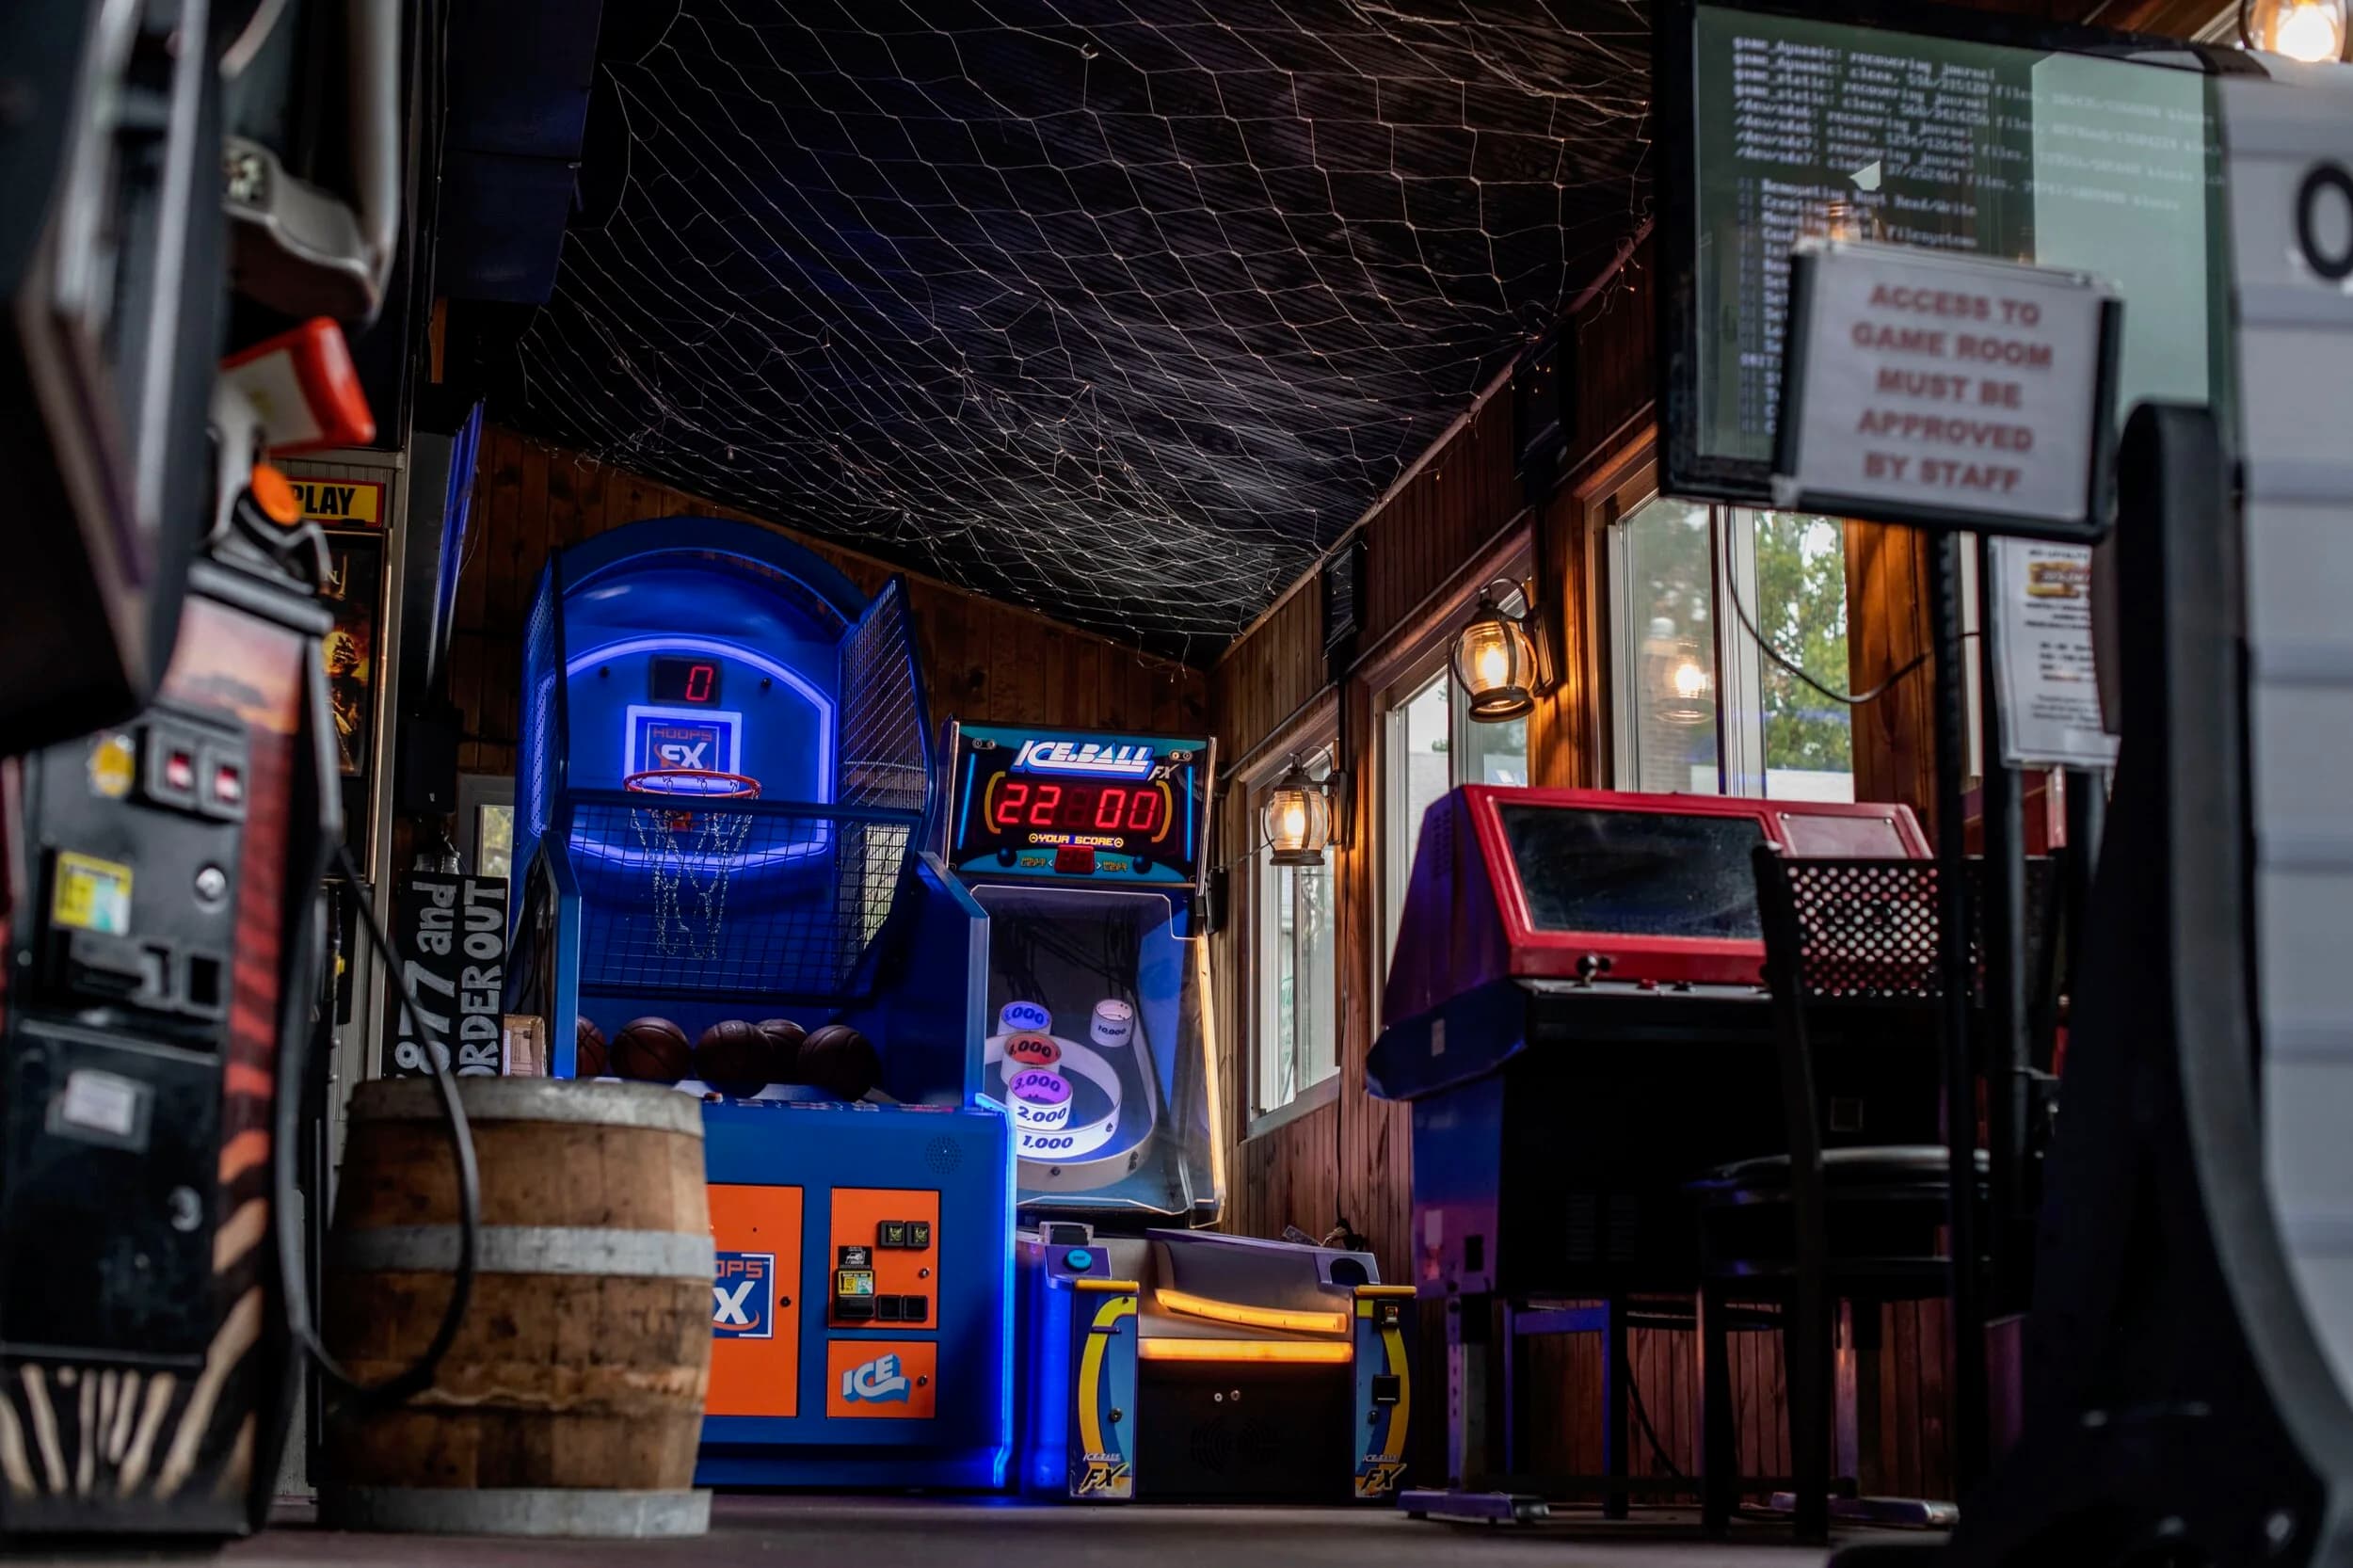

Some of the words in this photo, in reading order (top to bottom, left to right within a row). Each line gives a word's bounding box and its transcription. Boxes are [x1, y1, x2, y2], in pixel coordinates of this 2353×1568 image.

[1869, 282, 1990, 321] ACCESS
[1999, 298, 2041, 327] TO
[1850, 321, 1945, 357] GAME
[1956, 334, 2053, 368] ROOM
[1877, 368, 1970, 401] MUST
[1979, 380, 2022, 410] BE
[1856, 408, 2034, 454] APPROVED
[1863, 452, 1910, 480] BY
[1920, 456, 2023, 493] STAFF
[685, 665, 713, 701] 0
[653, 728, 712, 742] HOOPS
[1148, 763, 1179, 781] FX
[1038, 834, 1069, 844] YOUR
[1074, 835, 1115, 846] SCORE
[412, 881, 457, 956] and
[463, 879, 505, 960] OUT
[1097, 1024, 1127, 1036] 10,000
[1015, 1075, 1061, 1092] 3,000
[1017, 1106, 1067, 1123] 2,000
[1023, 1135, 1074, 1149] 1,000
[842, 1354, 906, 1398] ICE
[1078, 1462, 1129, 1495] FX
[1360, 1464, 1408, 1492] FX
